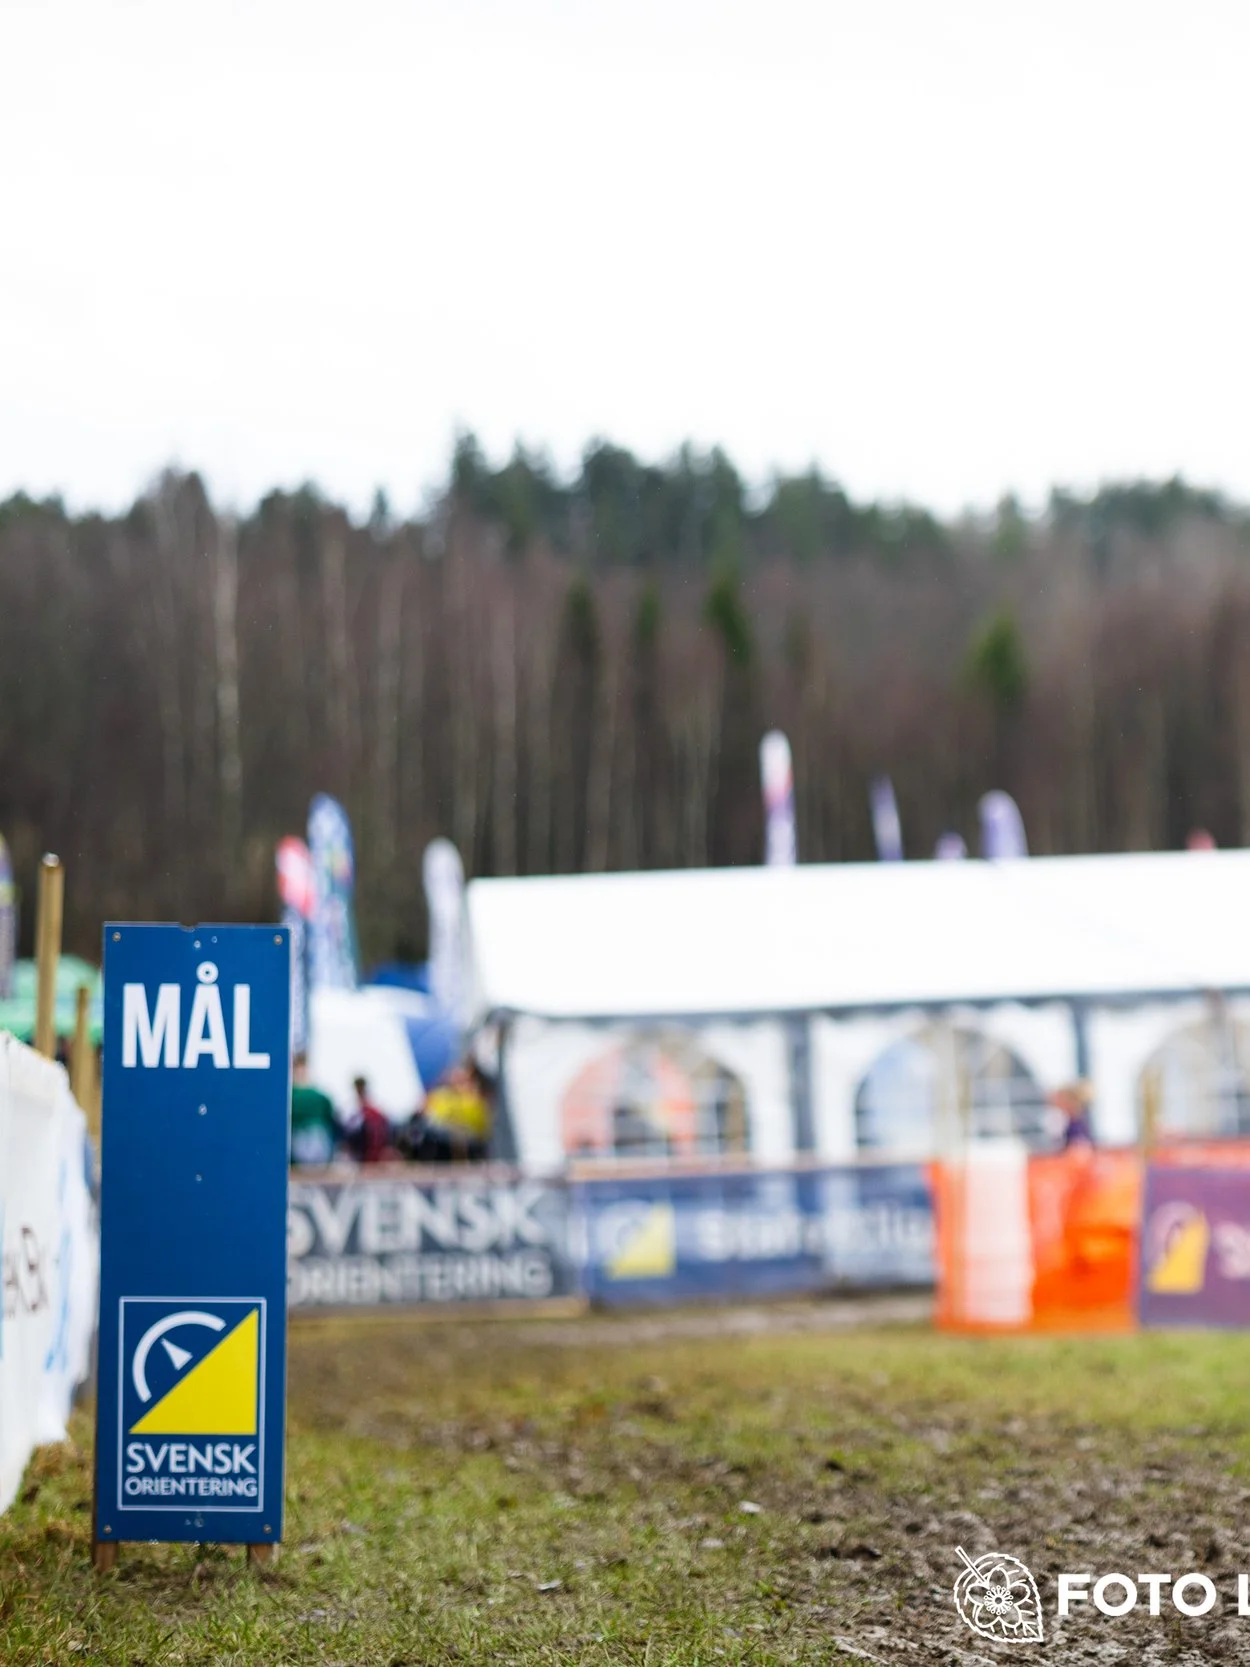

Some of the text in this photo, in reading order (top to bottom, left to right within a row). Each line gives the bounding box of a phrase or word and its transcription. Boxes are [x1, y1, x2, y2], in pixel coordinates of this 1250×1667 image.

[122, 961, 271, 1069] MÅL
[287, 1179, 546, 1256] SVENSK
[126, 1442, 258, 1475] SVENSK
[124, 1476, 258, 1497] ORIENTERING
